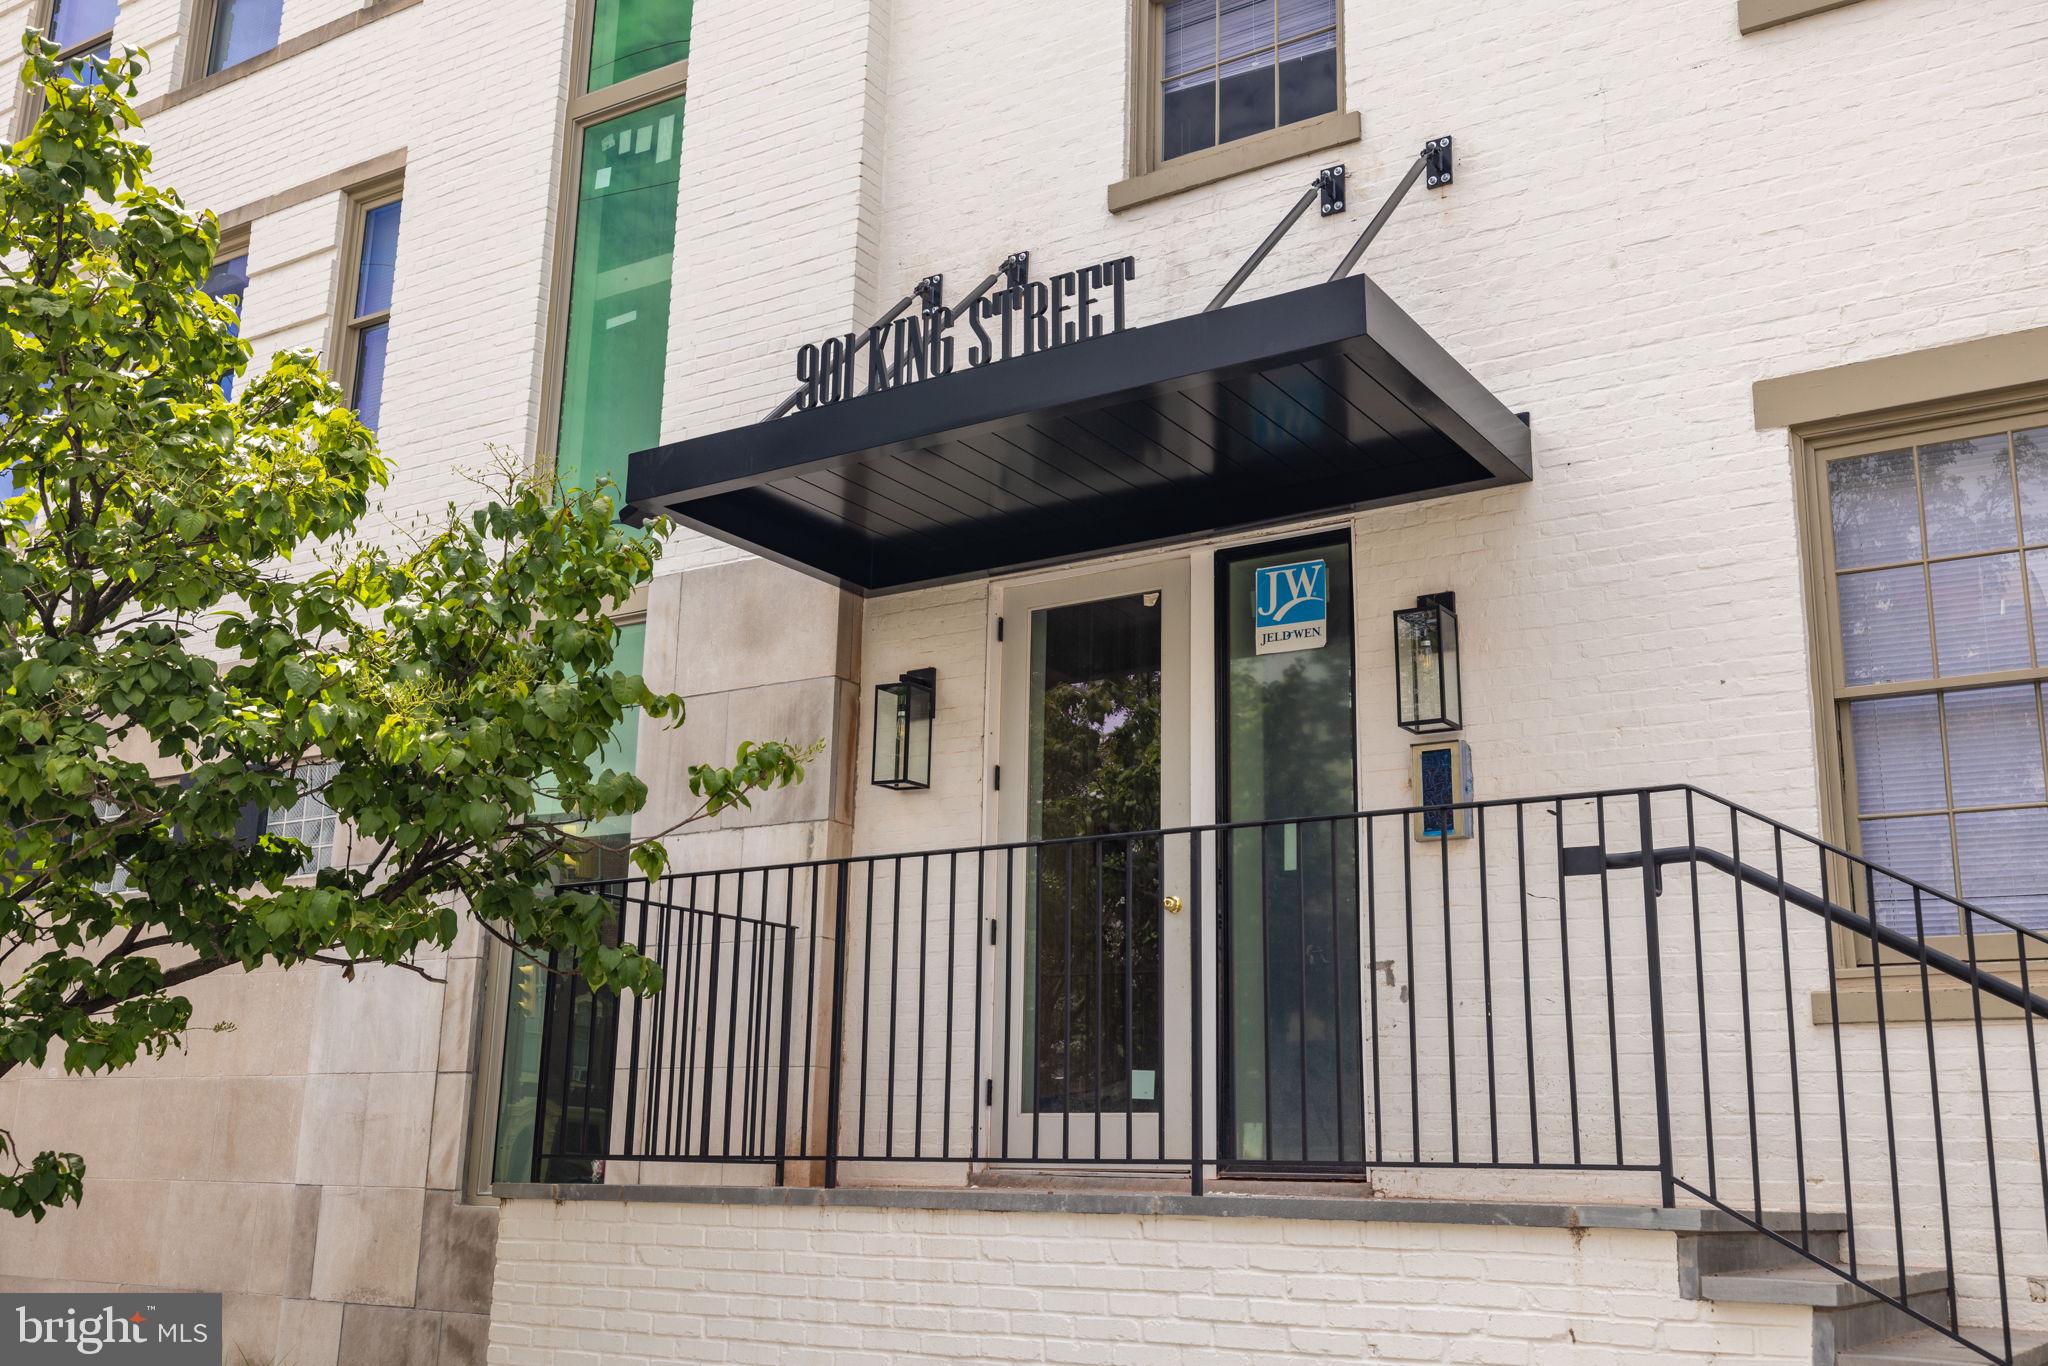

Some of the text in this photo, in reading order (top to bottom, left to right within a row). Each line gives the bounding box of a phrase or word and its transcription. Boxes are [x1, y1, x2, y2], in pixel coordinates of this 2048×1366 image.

[796, 255, 1136, 411] 901 KING STREET
[1257, 564, 1323, 616] JW
